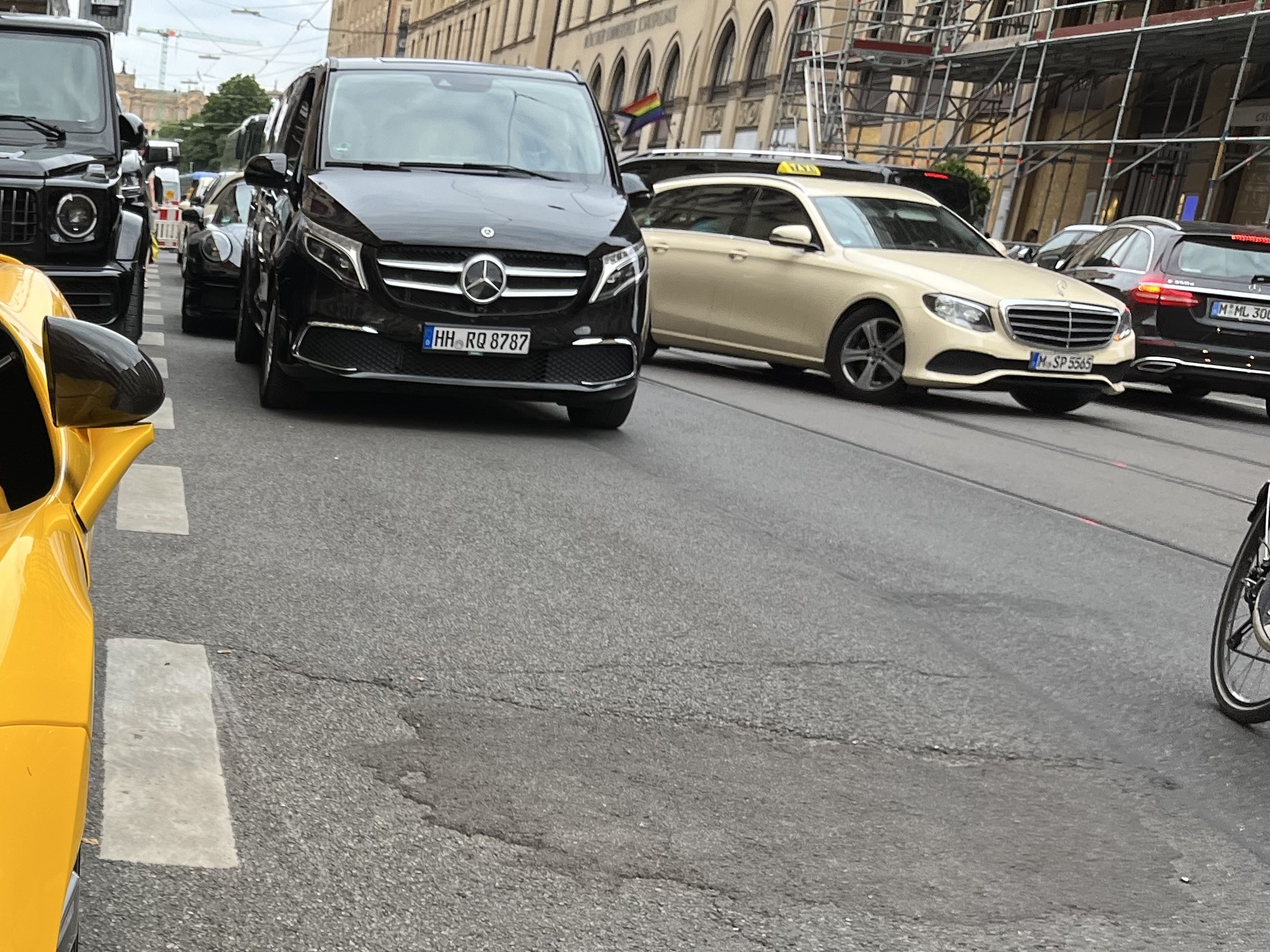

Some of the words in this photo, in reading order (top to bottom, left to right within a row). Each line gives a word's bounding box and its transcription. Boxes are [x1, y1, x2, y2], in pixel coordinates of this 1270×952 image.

[1218, 304, 1228, 315] M
[1234, 305, 1250, 317] ML
[435, 331, 455, 347] HH
[466, 332, 487, 349] RQ
[490, 332, 529, 351] 8787
[1053, 355, 1067, 369] SP
